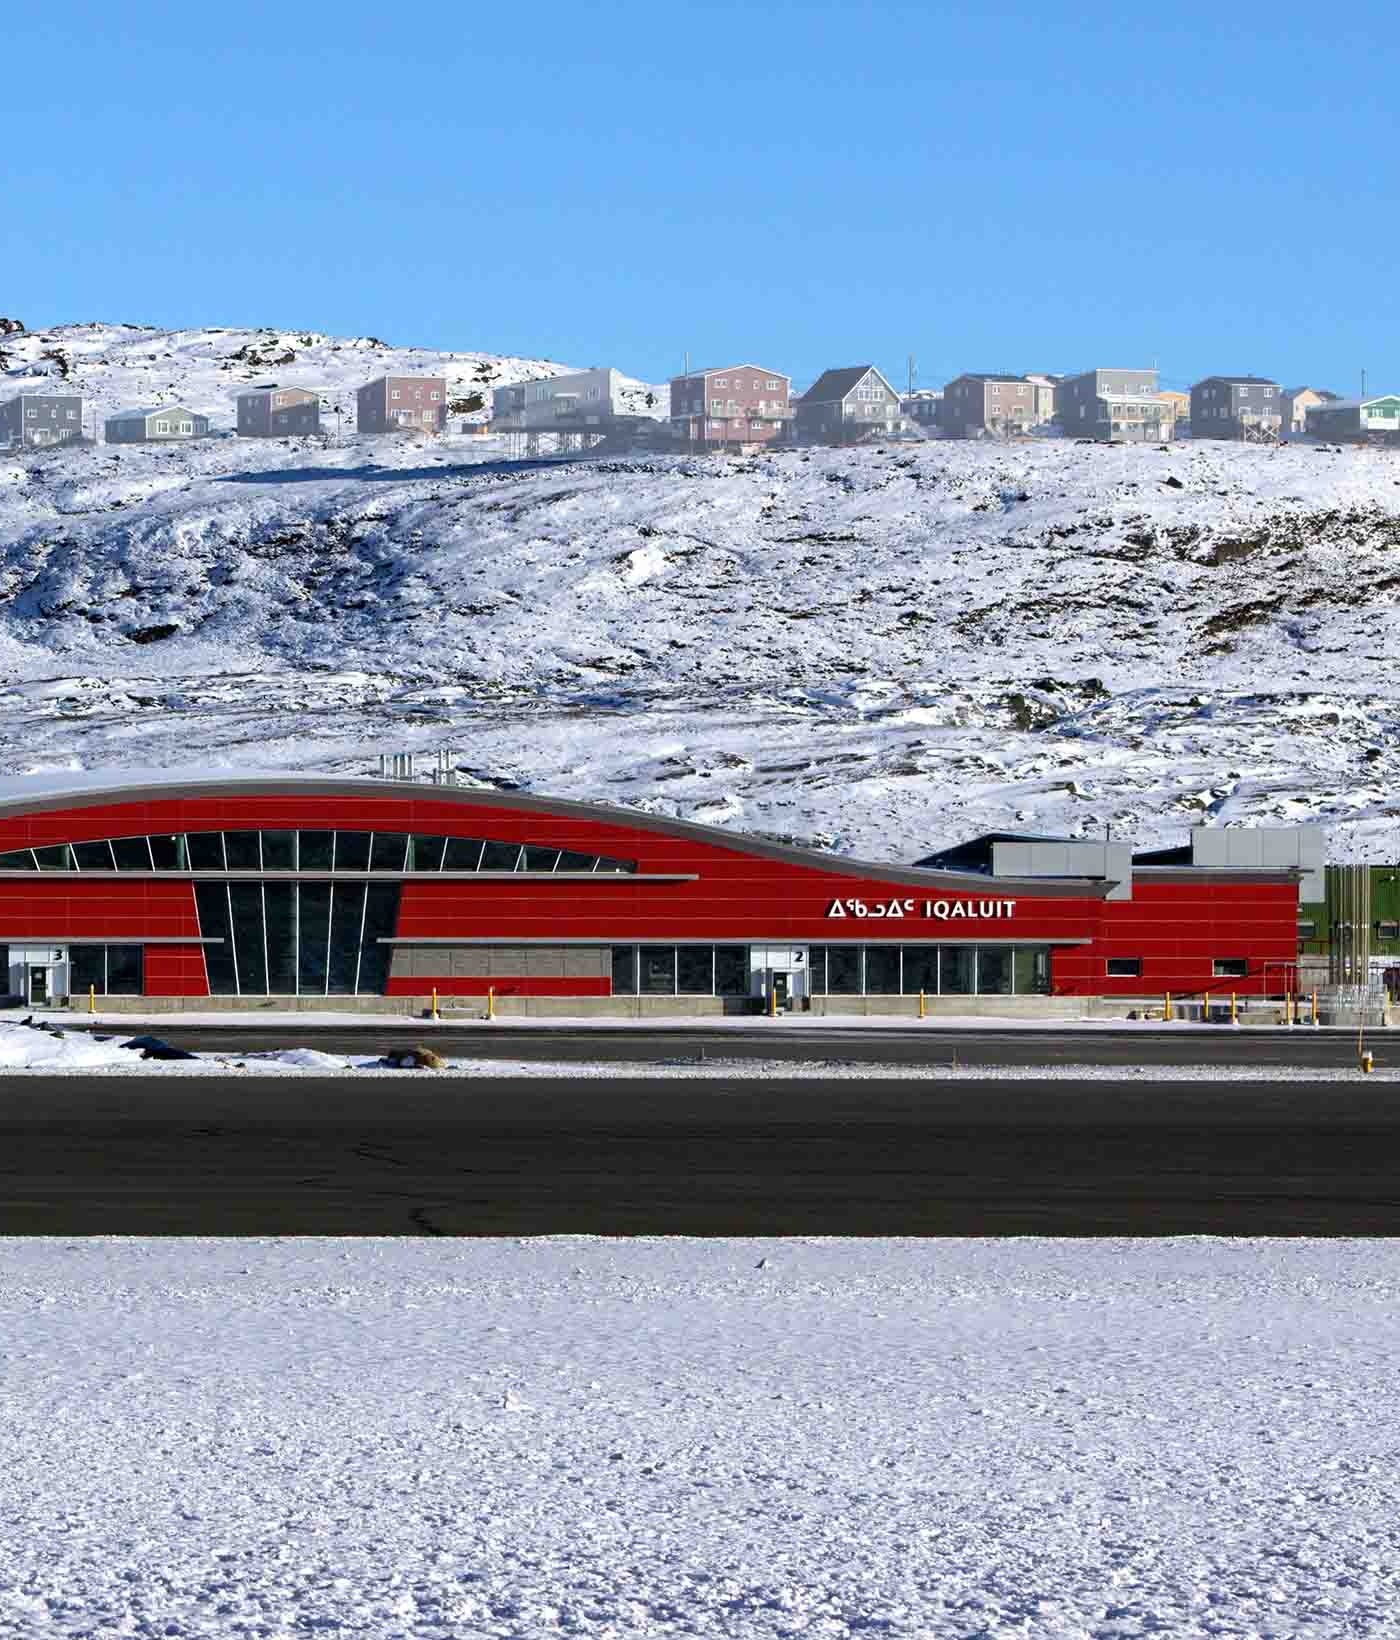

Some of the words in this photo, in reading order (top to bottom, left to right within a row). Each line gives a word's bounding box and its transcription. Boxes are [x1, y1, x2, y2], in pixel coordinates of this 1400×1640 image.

[926, 901, 1017, 919] IQALUIT
[54, 950, 62, 960] 3
[794, 951, 803, 962] 2
